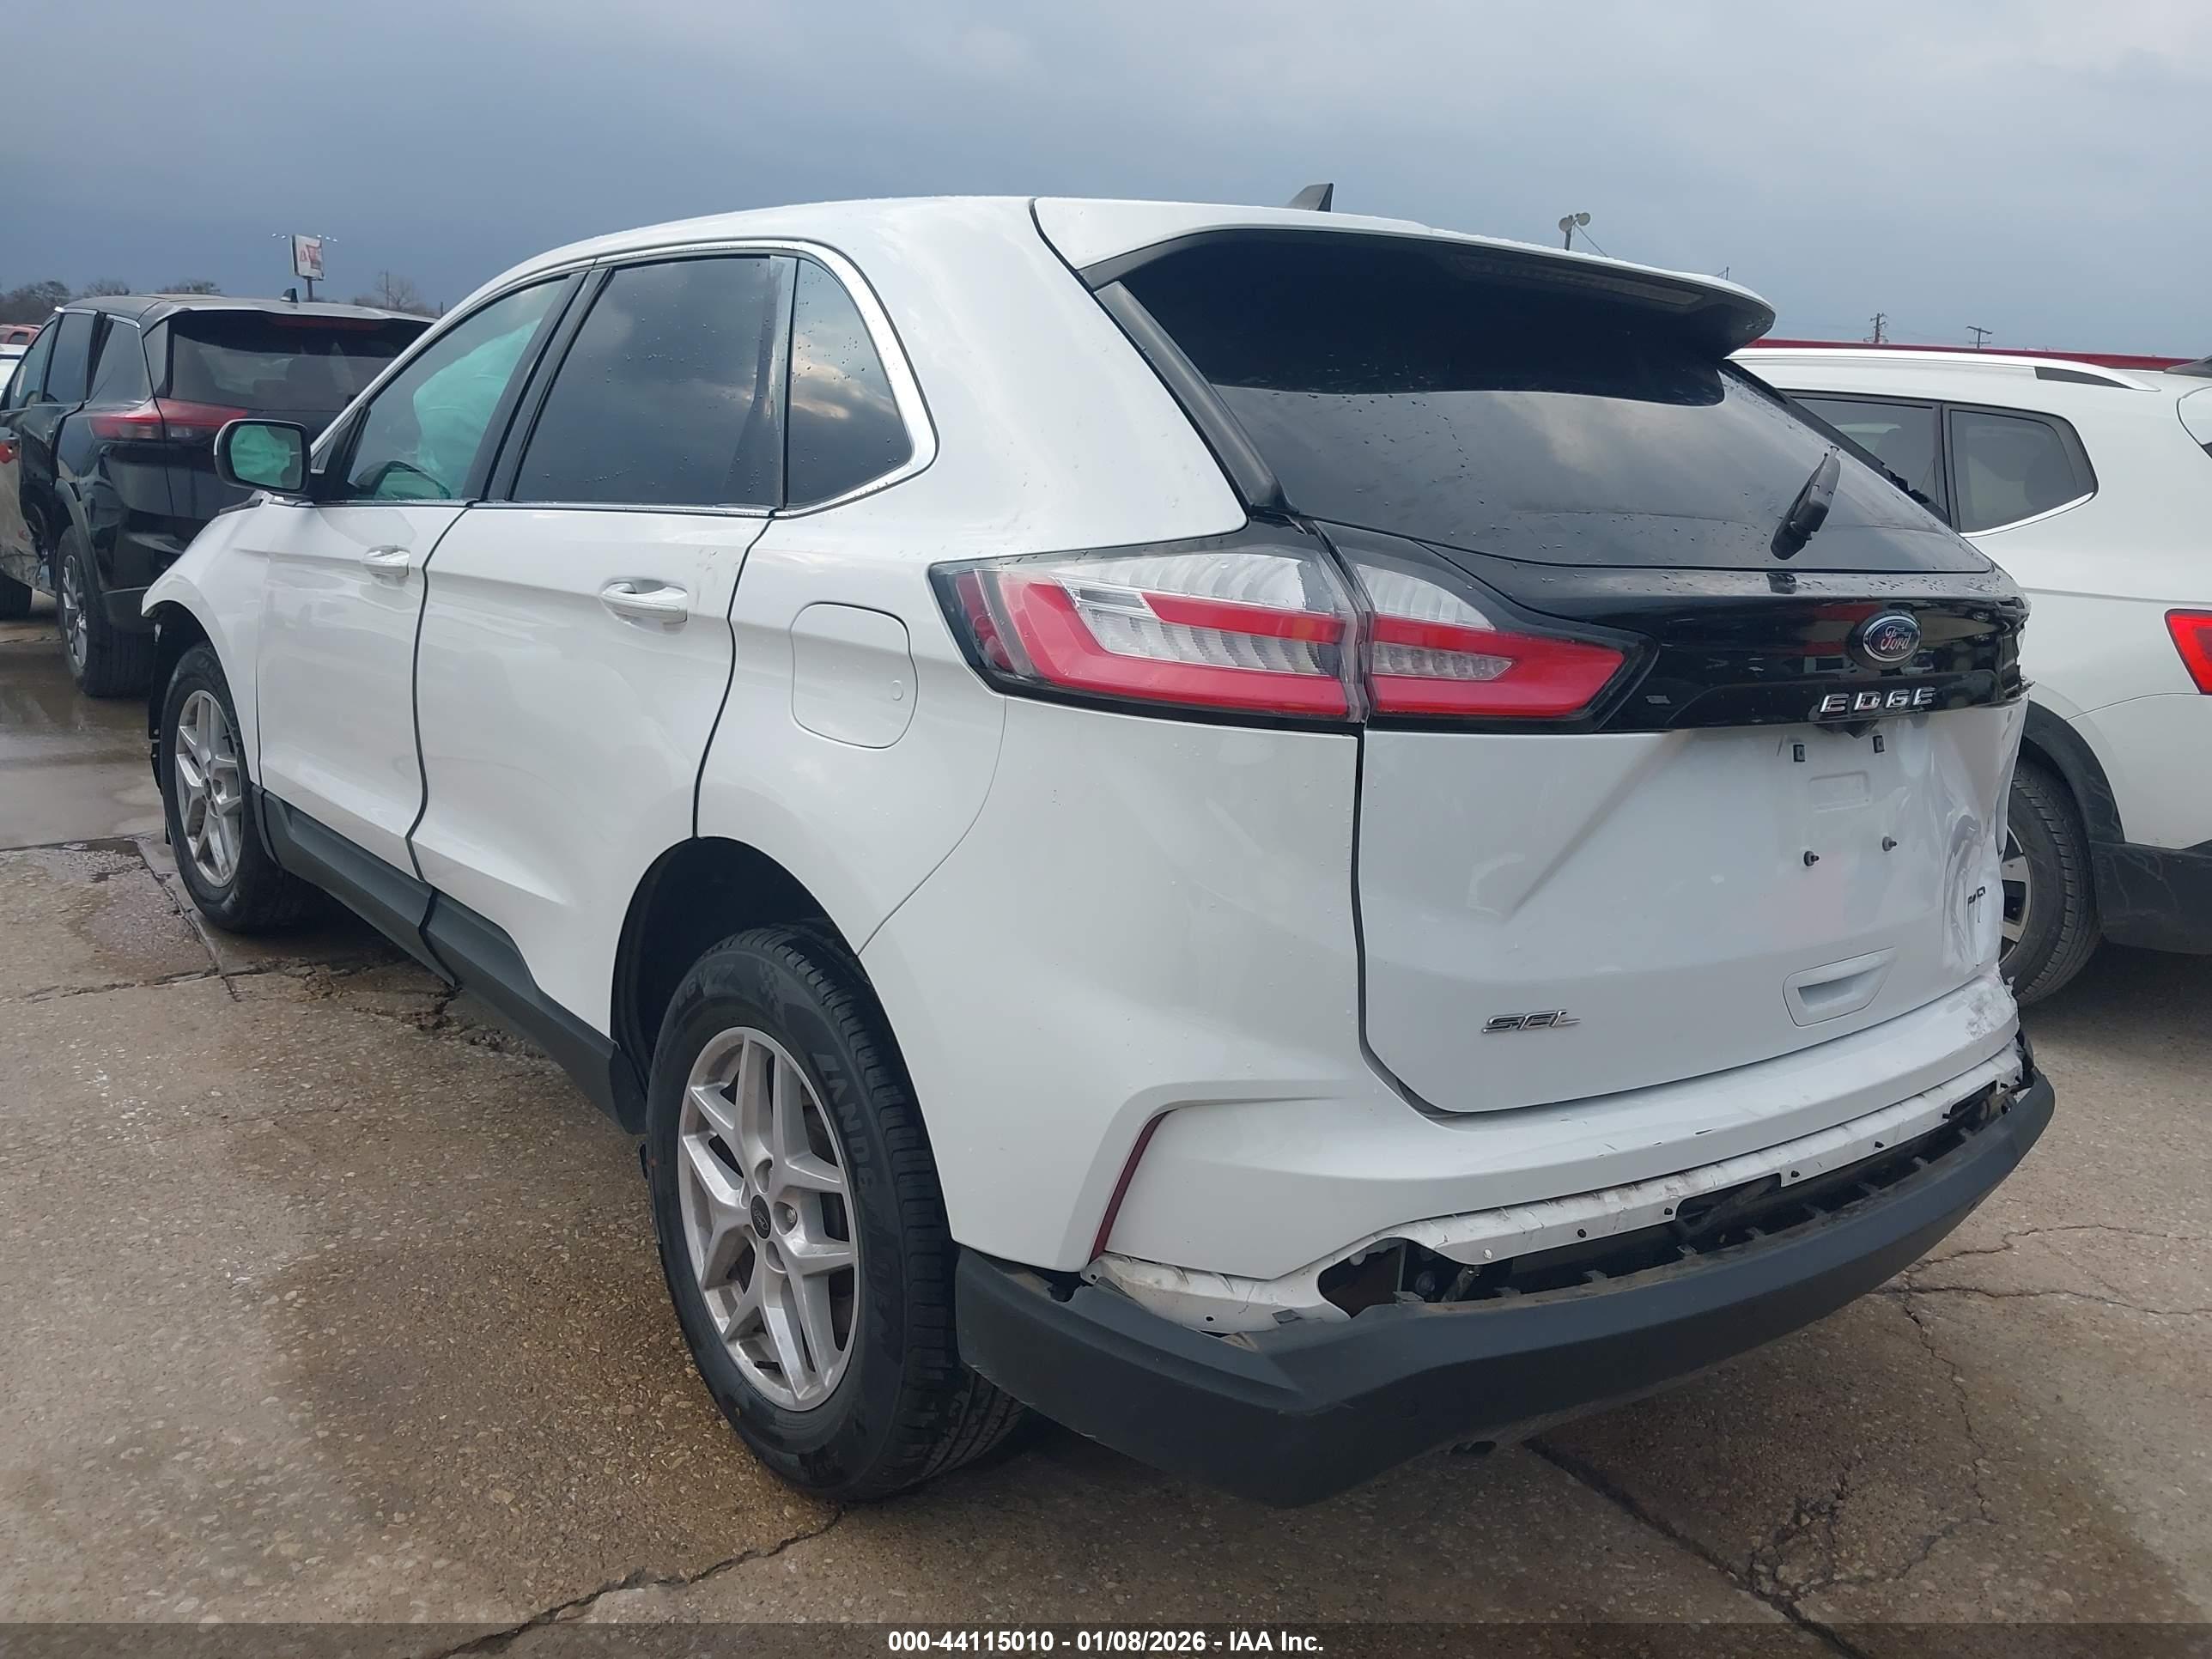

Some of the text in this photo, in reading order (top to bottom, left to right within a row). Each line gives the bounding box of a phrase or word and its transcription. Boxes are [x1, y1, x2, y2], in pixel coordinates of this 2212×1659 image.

[1881, 625, 1911, 651] Ford
[1820, 687, 1937, 713] EDGE
[1481, 1009, 1581, 1034] SEL
